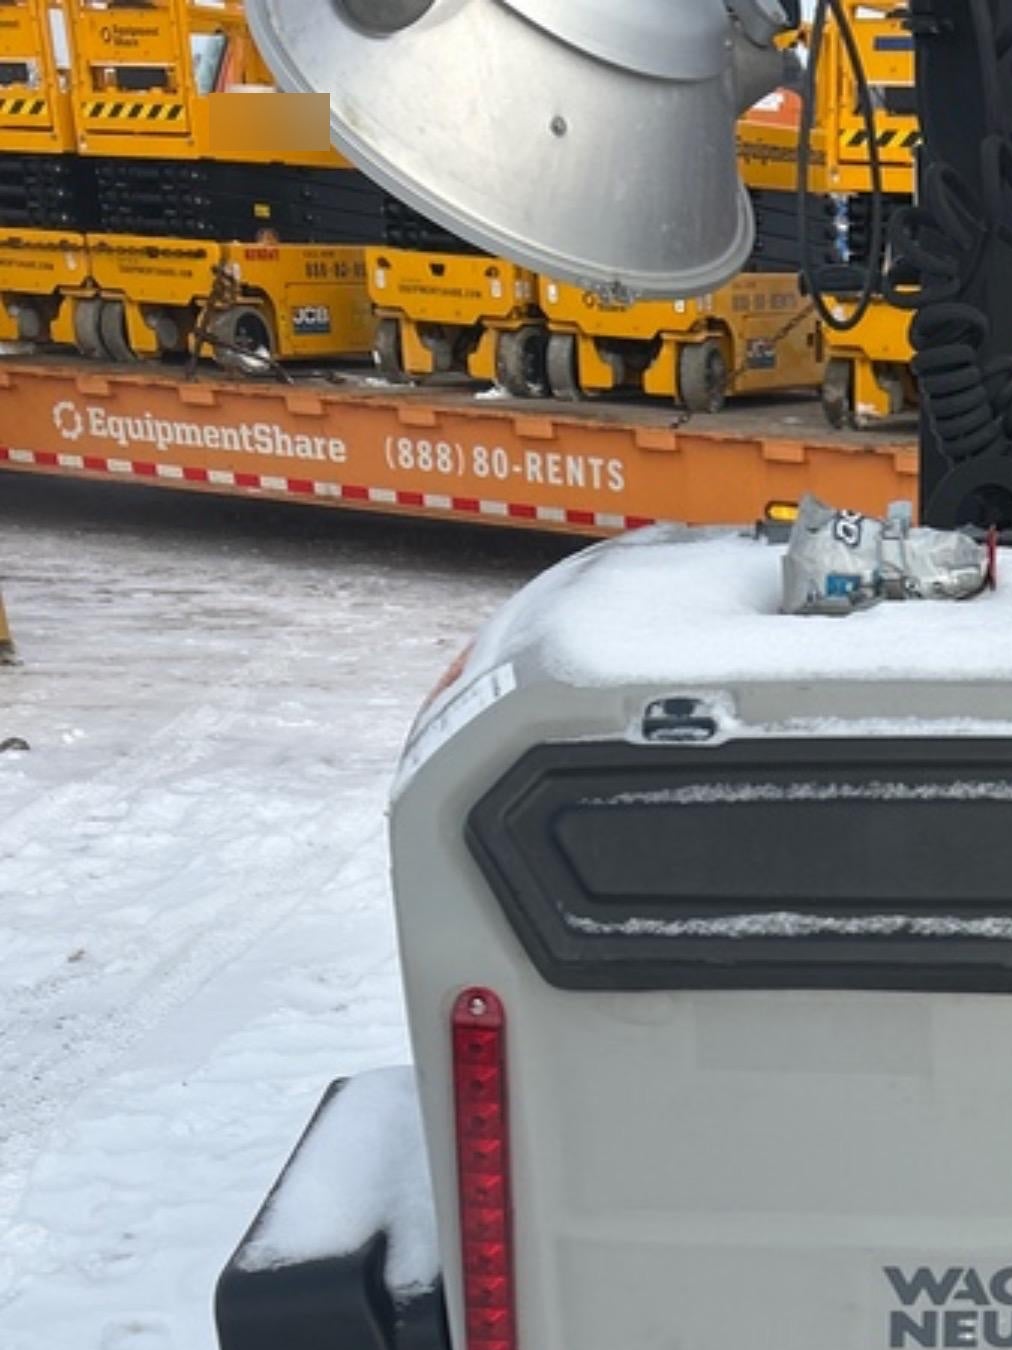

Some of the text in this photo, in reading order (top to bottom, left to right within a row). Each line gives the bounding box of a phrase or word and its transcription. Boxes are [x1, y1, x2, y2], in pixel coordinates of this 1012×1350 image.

[87, 406, 625, 491] EquipmentShare (888) 80-RENTS
